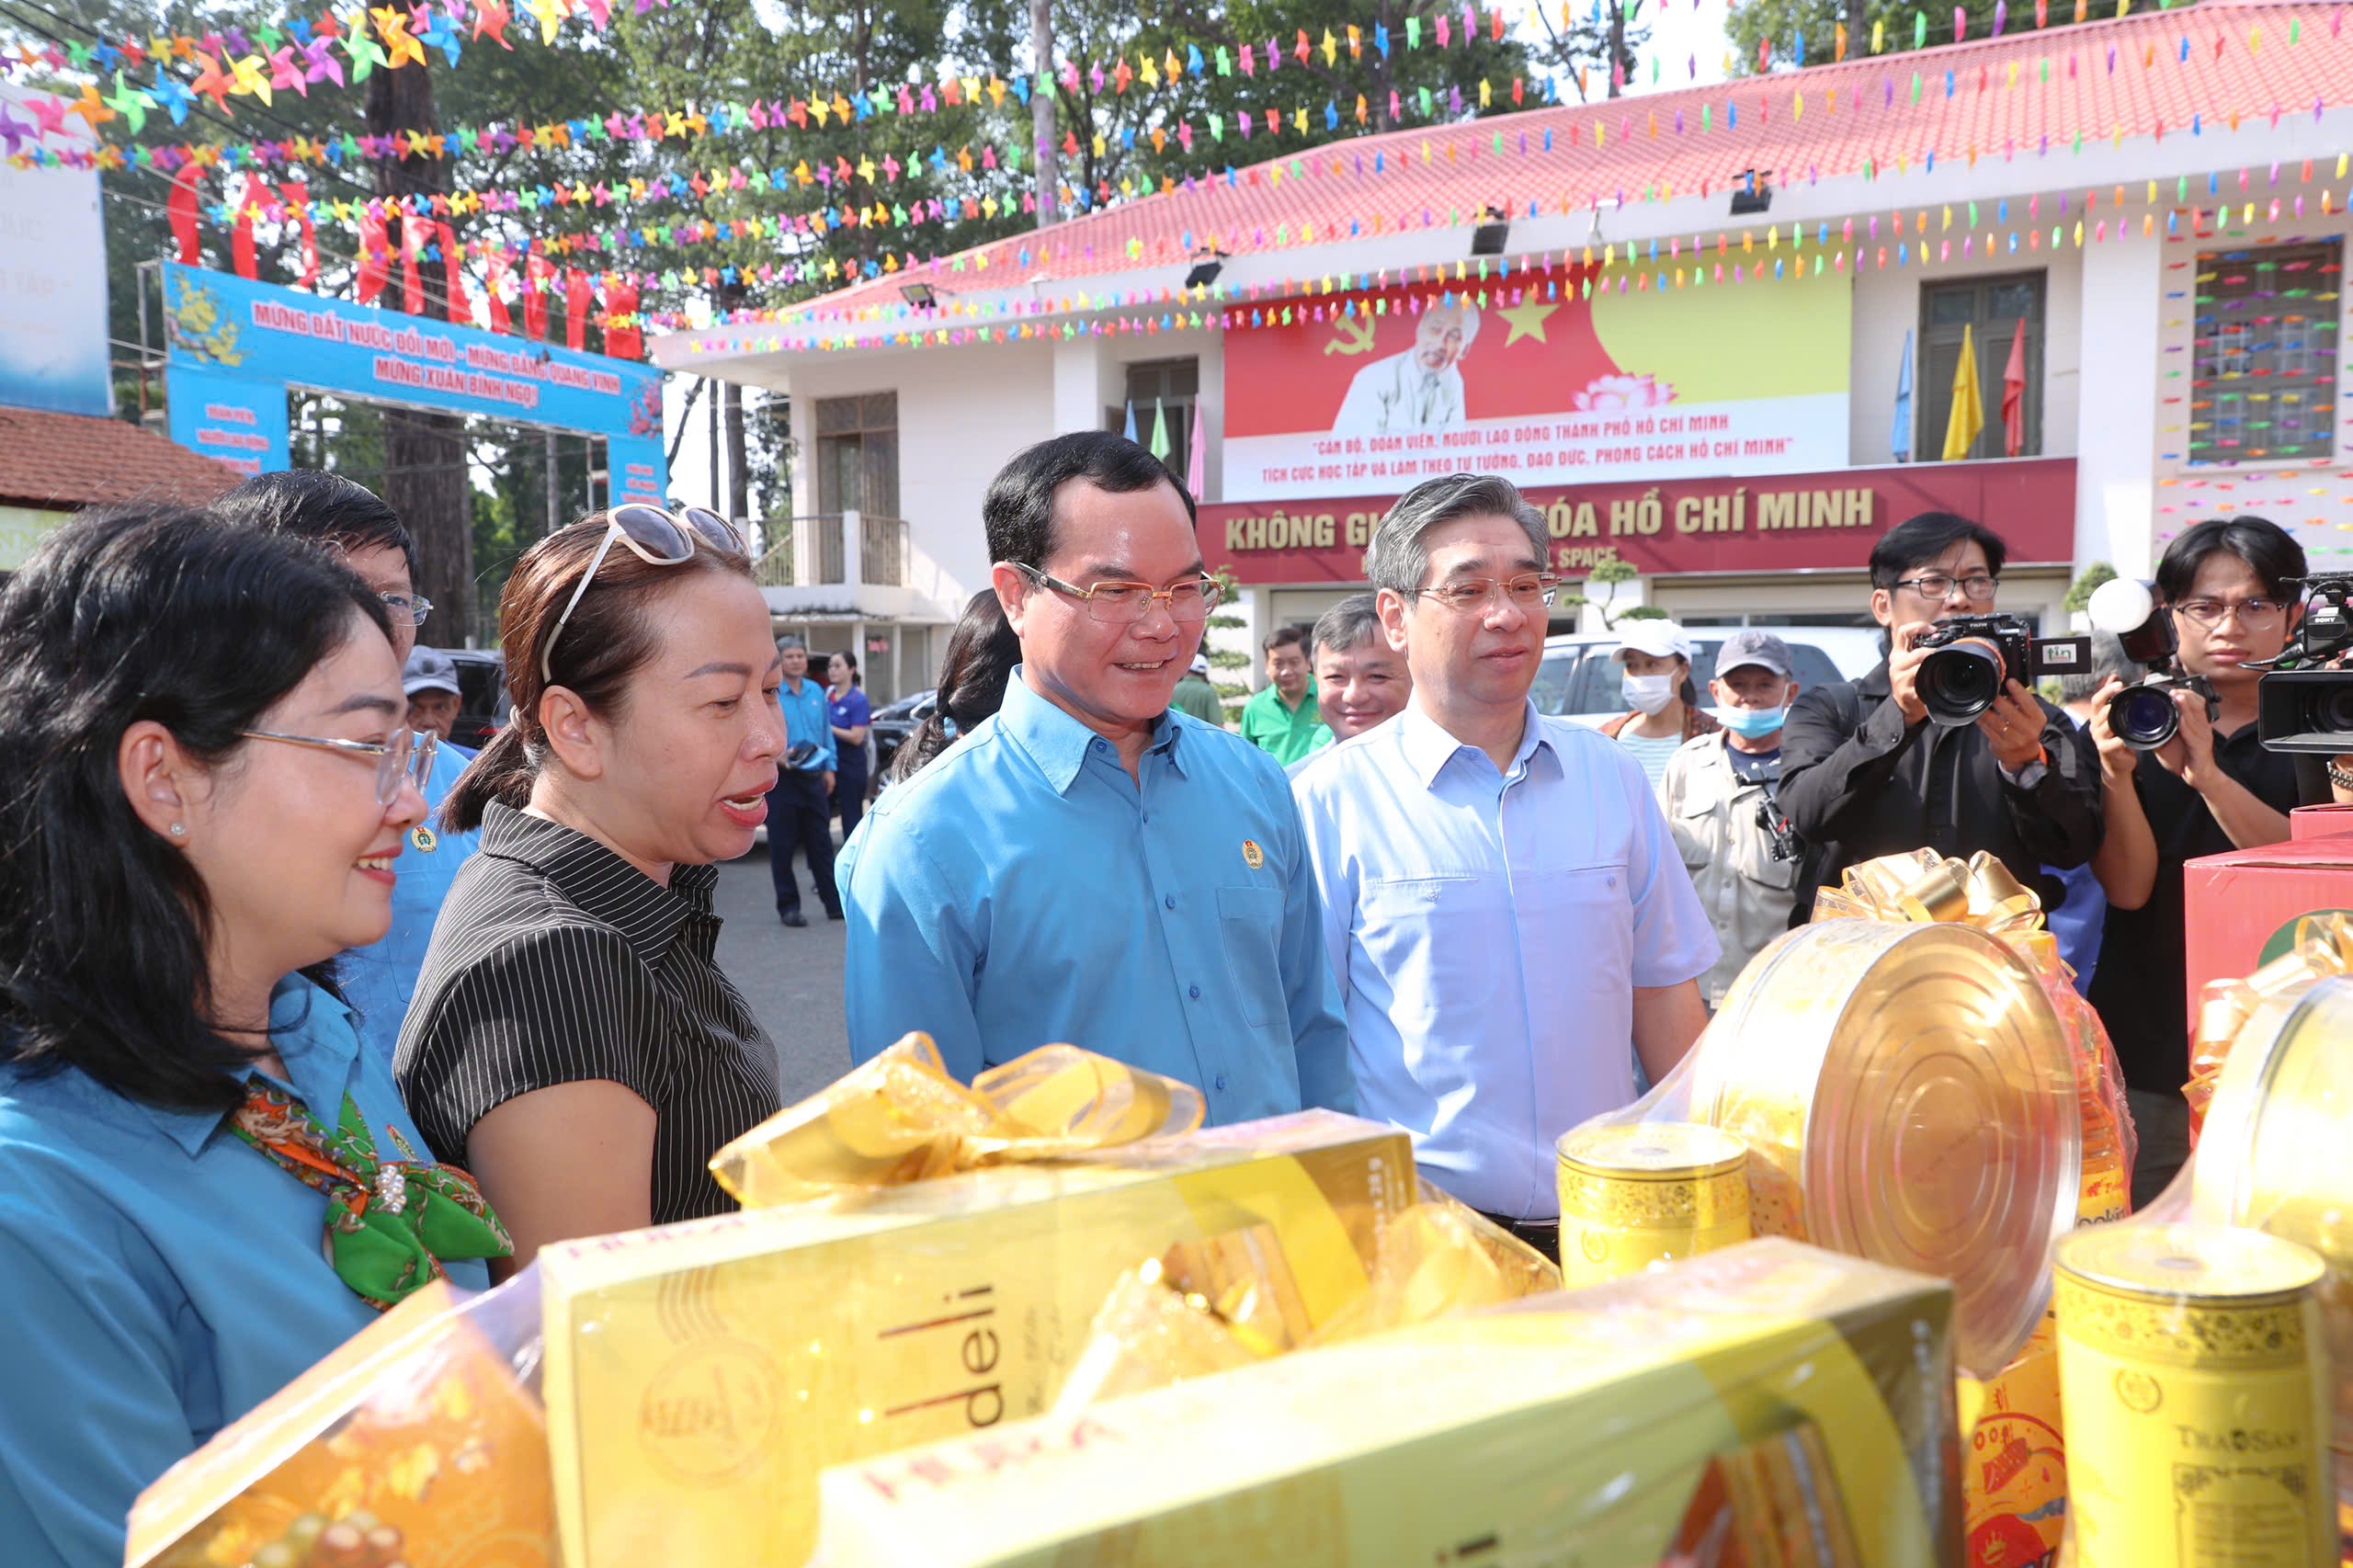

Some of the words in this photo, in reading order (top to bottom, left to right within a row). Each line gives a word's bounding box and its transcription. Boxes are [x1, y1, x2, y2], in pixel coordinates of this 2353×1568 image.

[253, 300, 309, 335] MỪNG
[312, 308, 345, 341] ĐẤT
[347, 321, 392, 350] NƯỚC
[426, 334, 456, 361] MỚI
[374, 357, 421, 385] MỪNG
[425, 366, 465, 392] XUÂN
[1486, 427, 1509, 443] LAO
[1660, 413, 1684, 433] CHÍ
[1688, 414, 1729, 431] MINH
[1422, 458, 1452, 473] THEO
[1595, 445, 1641, 464] PHONG
[1713, 437, 1739, 457] CHÍ
[1225, 510, 1336, 550] KHÔNG
[1346, 512, 1379, 546] GI
[1537, 495, 1598, 539] ÓA
[1610, 487, 1663, 536] HỒ
[1675, 487, 1747, 534] CHÍ
[1756, 488, 1874, 530] MINH
[879, 1284, 1004, 1428] deli
